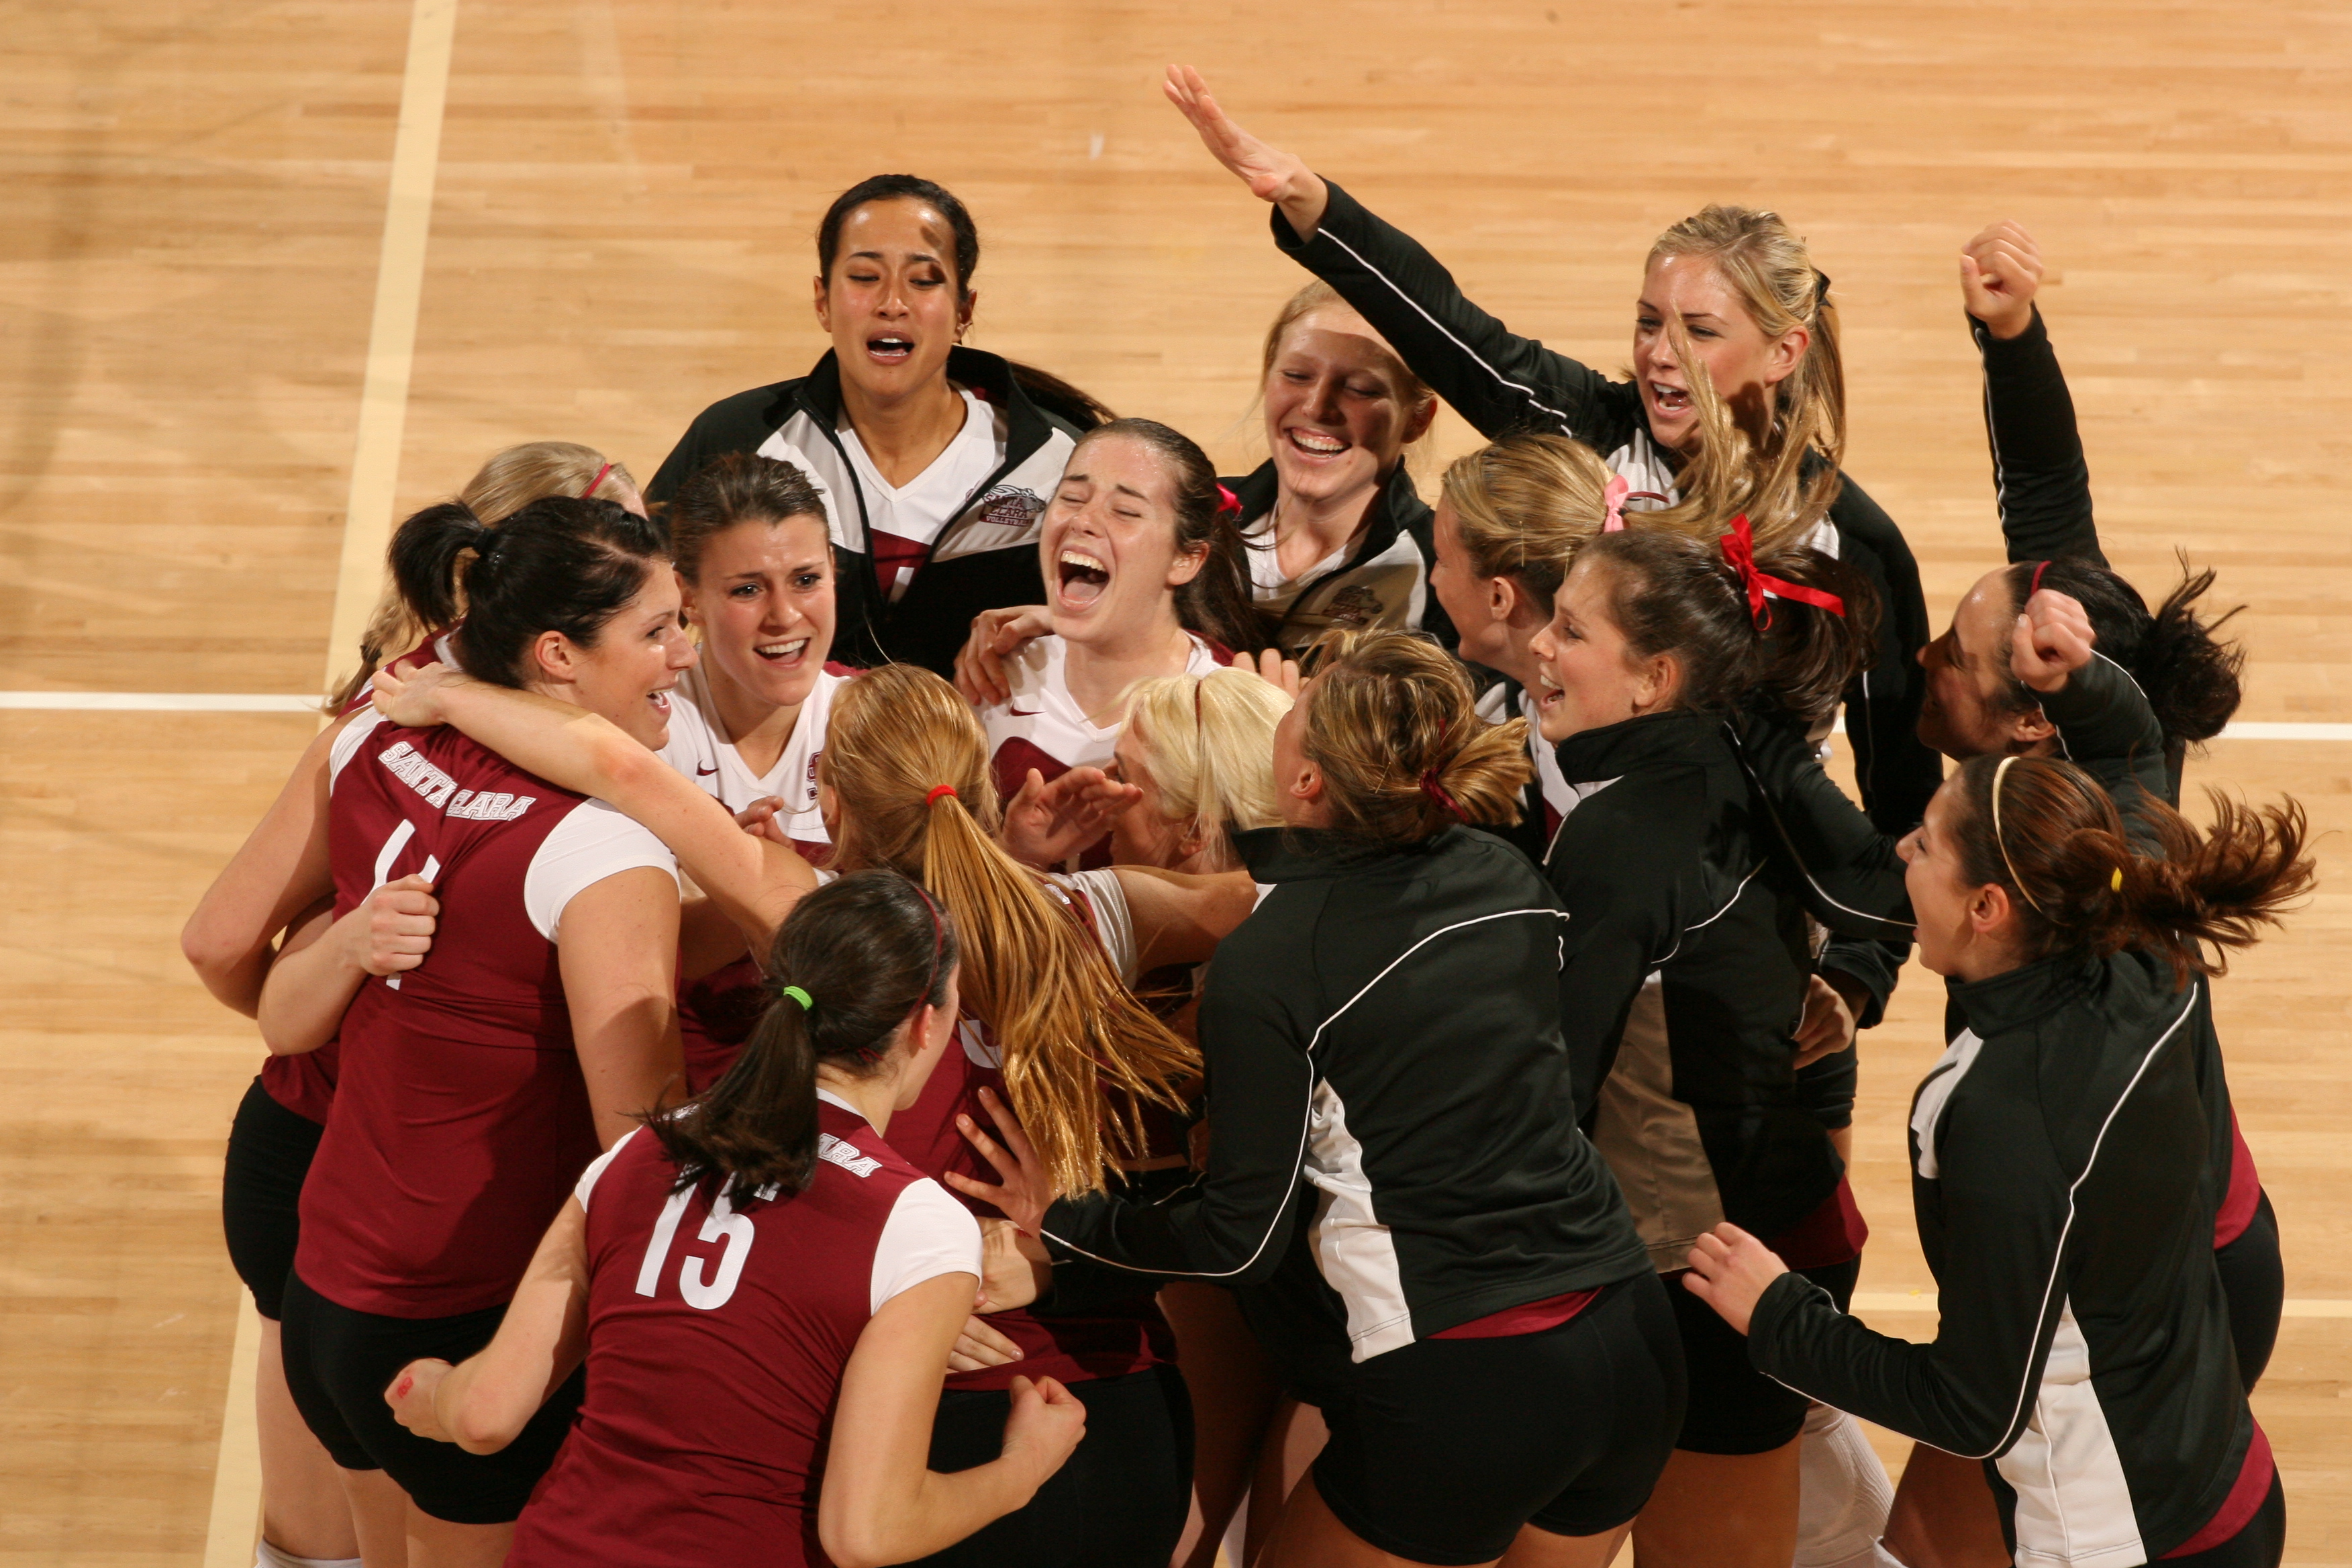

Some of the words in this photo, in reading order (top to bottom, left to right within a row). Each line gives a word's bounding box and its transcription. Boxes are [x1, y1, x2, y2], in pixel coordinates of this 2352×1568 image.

[991, 505, 1028, 519] CLARA
[378, 741, 458, 809] SANTA
[446, 789, 537, 821] CLARA
[818, 1132, 883, 1178] ARA
[635, 1163, 781, 1310] 15
